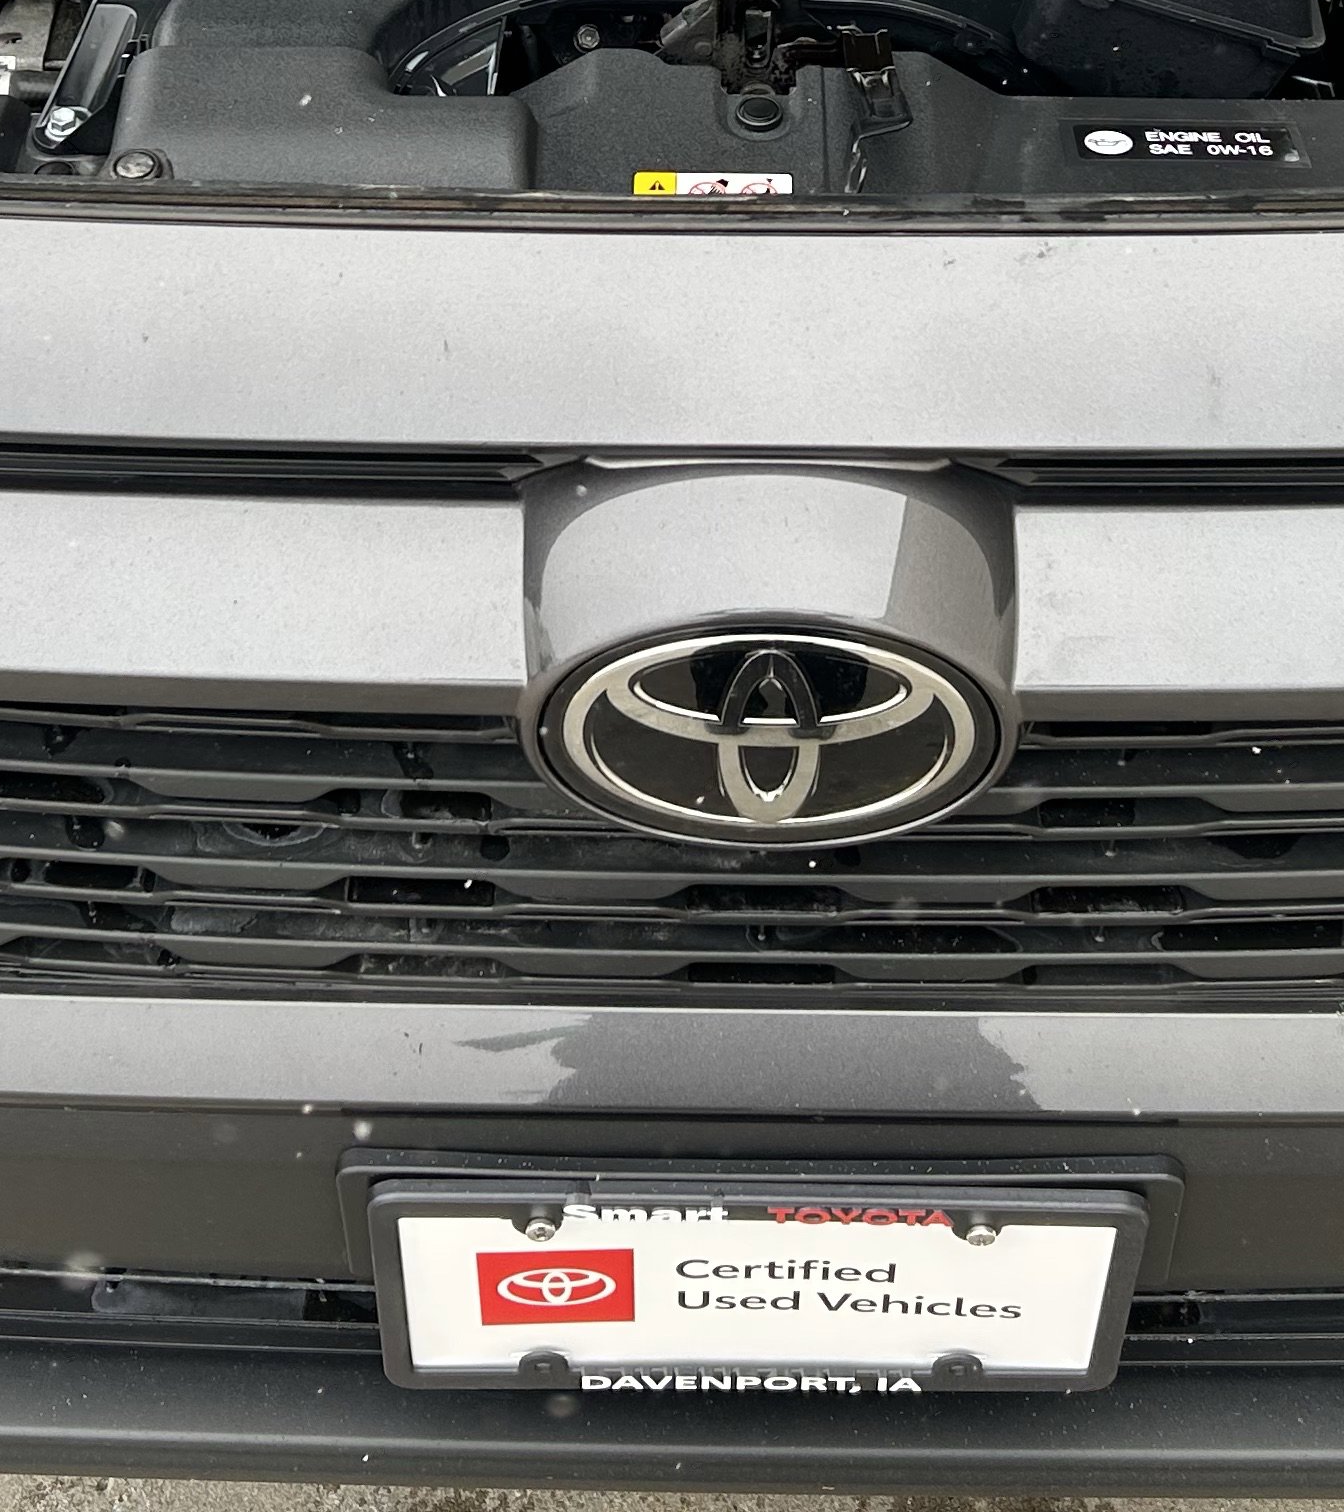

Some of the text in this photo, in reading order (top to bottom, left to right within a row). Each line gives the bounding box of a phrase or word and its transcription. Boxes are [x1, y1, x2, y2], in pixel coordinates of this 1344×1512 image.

[1144, 131, 1270, 144] ENGINE OIL
[1148, 143, 1274, 157] SAE 0W-16
[562, 1204, 954, 1227] Smart TOYOTA
[676, 1259, 897, 1284] Certified
[678, 1290, 1021, 1320] Used Vehicles
[581, 1376, 922, 1394] DAVENPORT, IA
